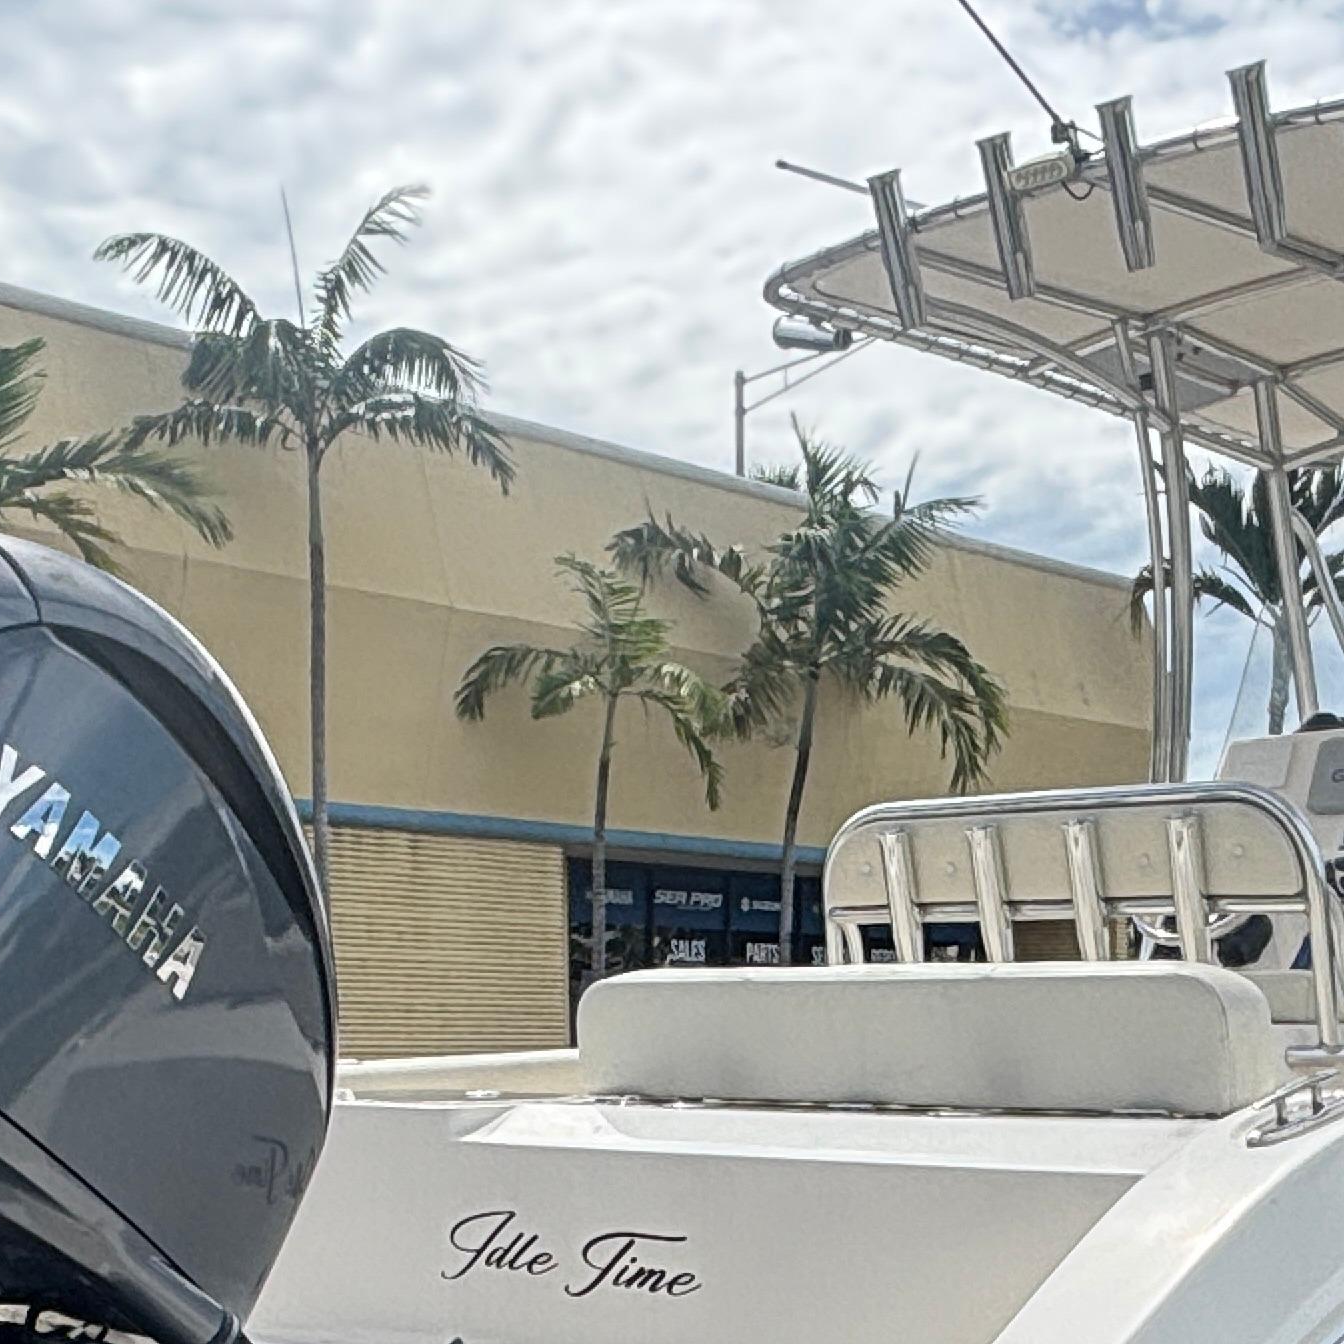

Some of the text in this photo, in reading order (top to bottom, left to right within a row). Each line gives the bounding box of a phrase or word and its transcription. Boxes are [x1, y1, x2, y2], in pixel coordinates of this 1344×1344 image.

[669, 938, 705, 962] SALES
[441, 1210, 703, 1298] Idle Time
